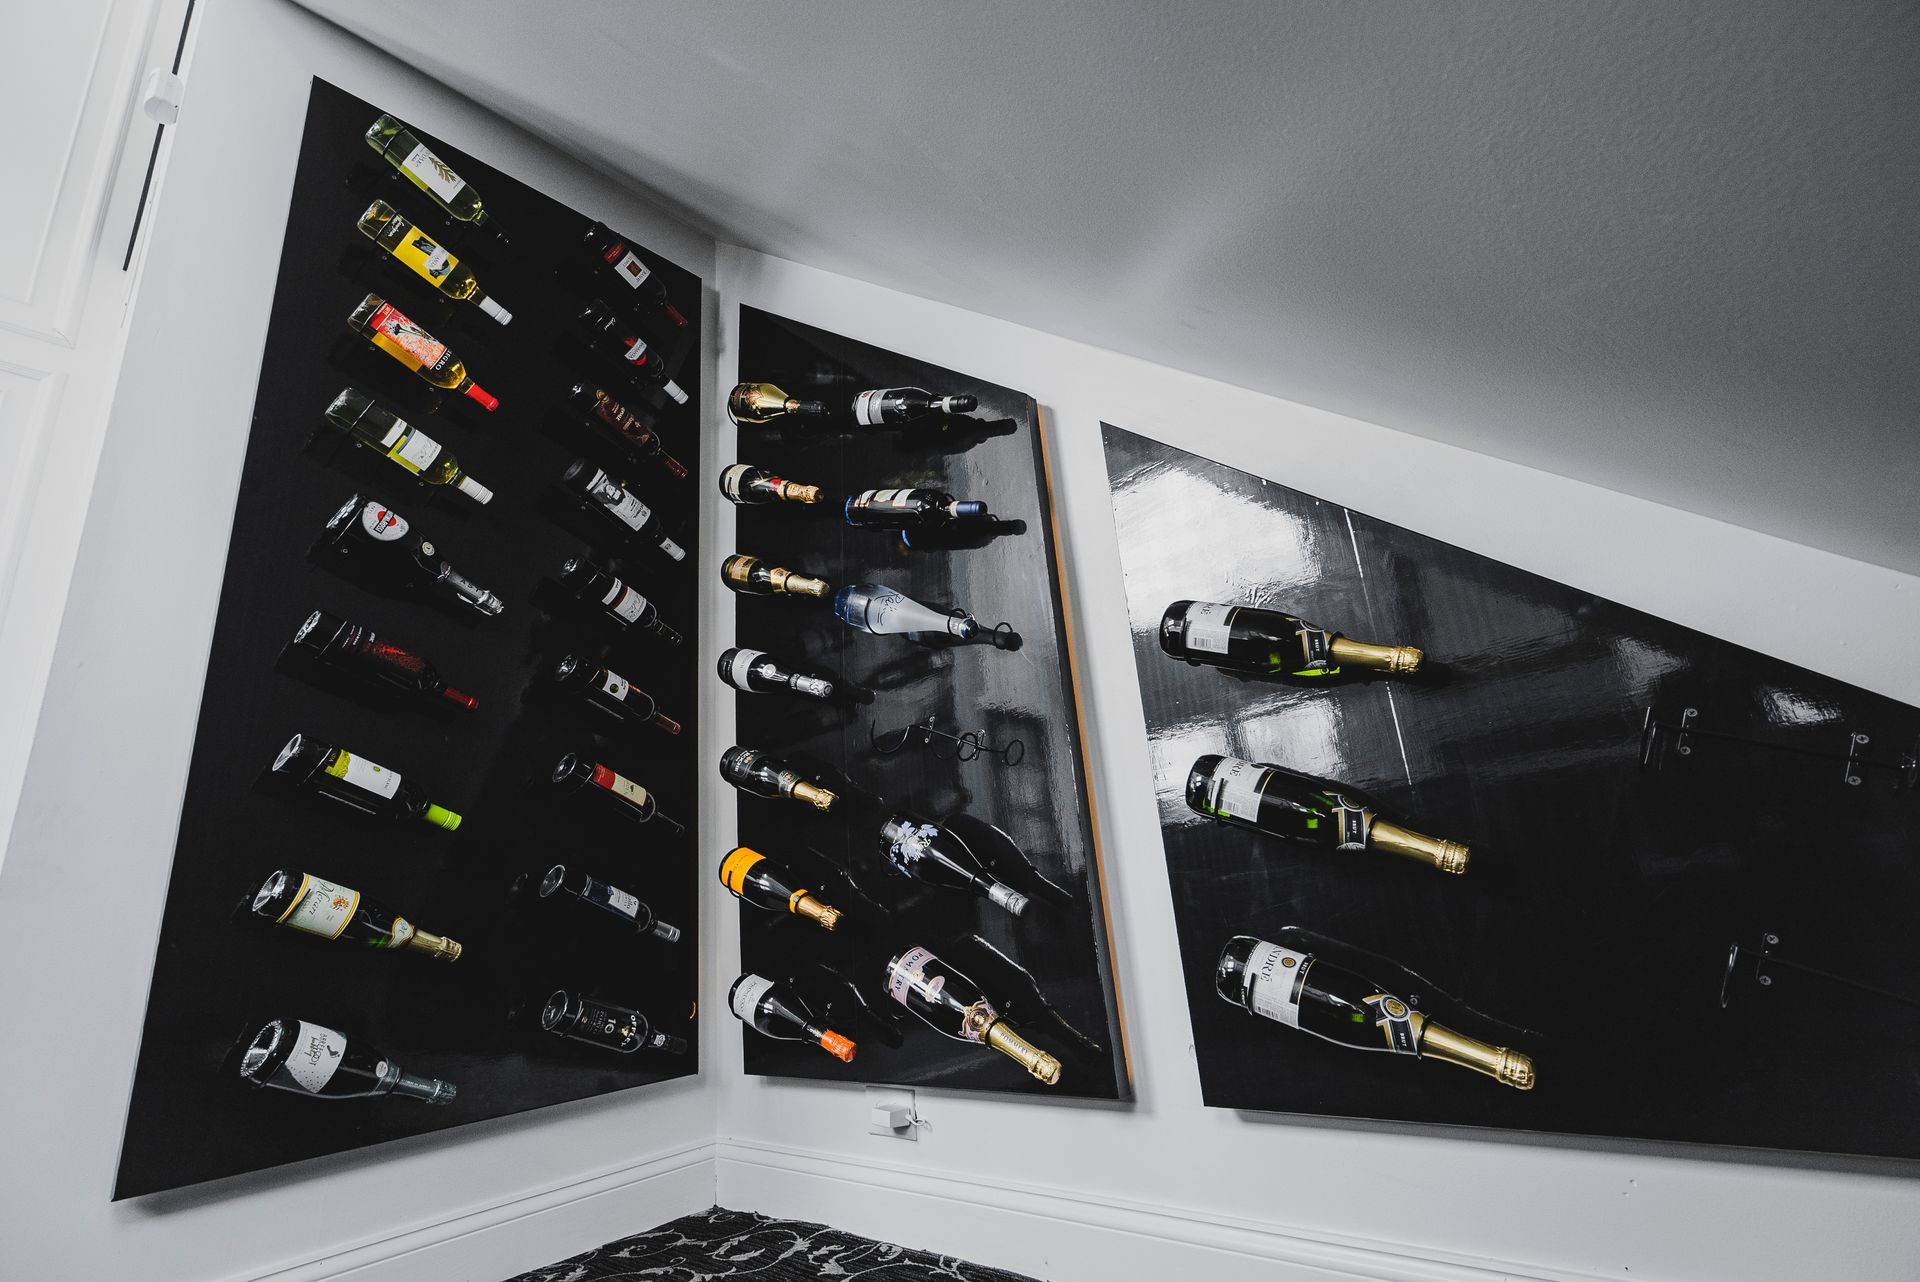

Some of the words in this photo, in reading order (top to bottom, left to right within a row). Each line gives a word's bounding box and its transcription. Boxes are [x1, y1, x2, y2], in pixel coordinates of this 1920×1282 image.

[1299, 961, 1309, 975] BRUT
[621, 1014, 637, 1047] OFFLEY
[1399, 1032, 1407, 1047] BRUT
[309, 1033, 327, 1066] BAREFOOT
